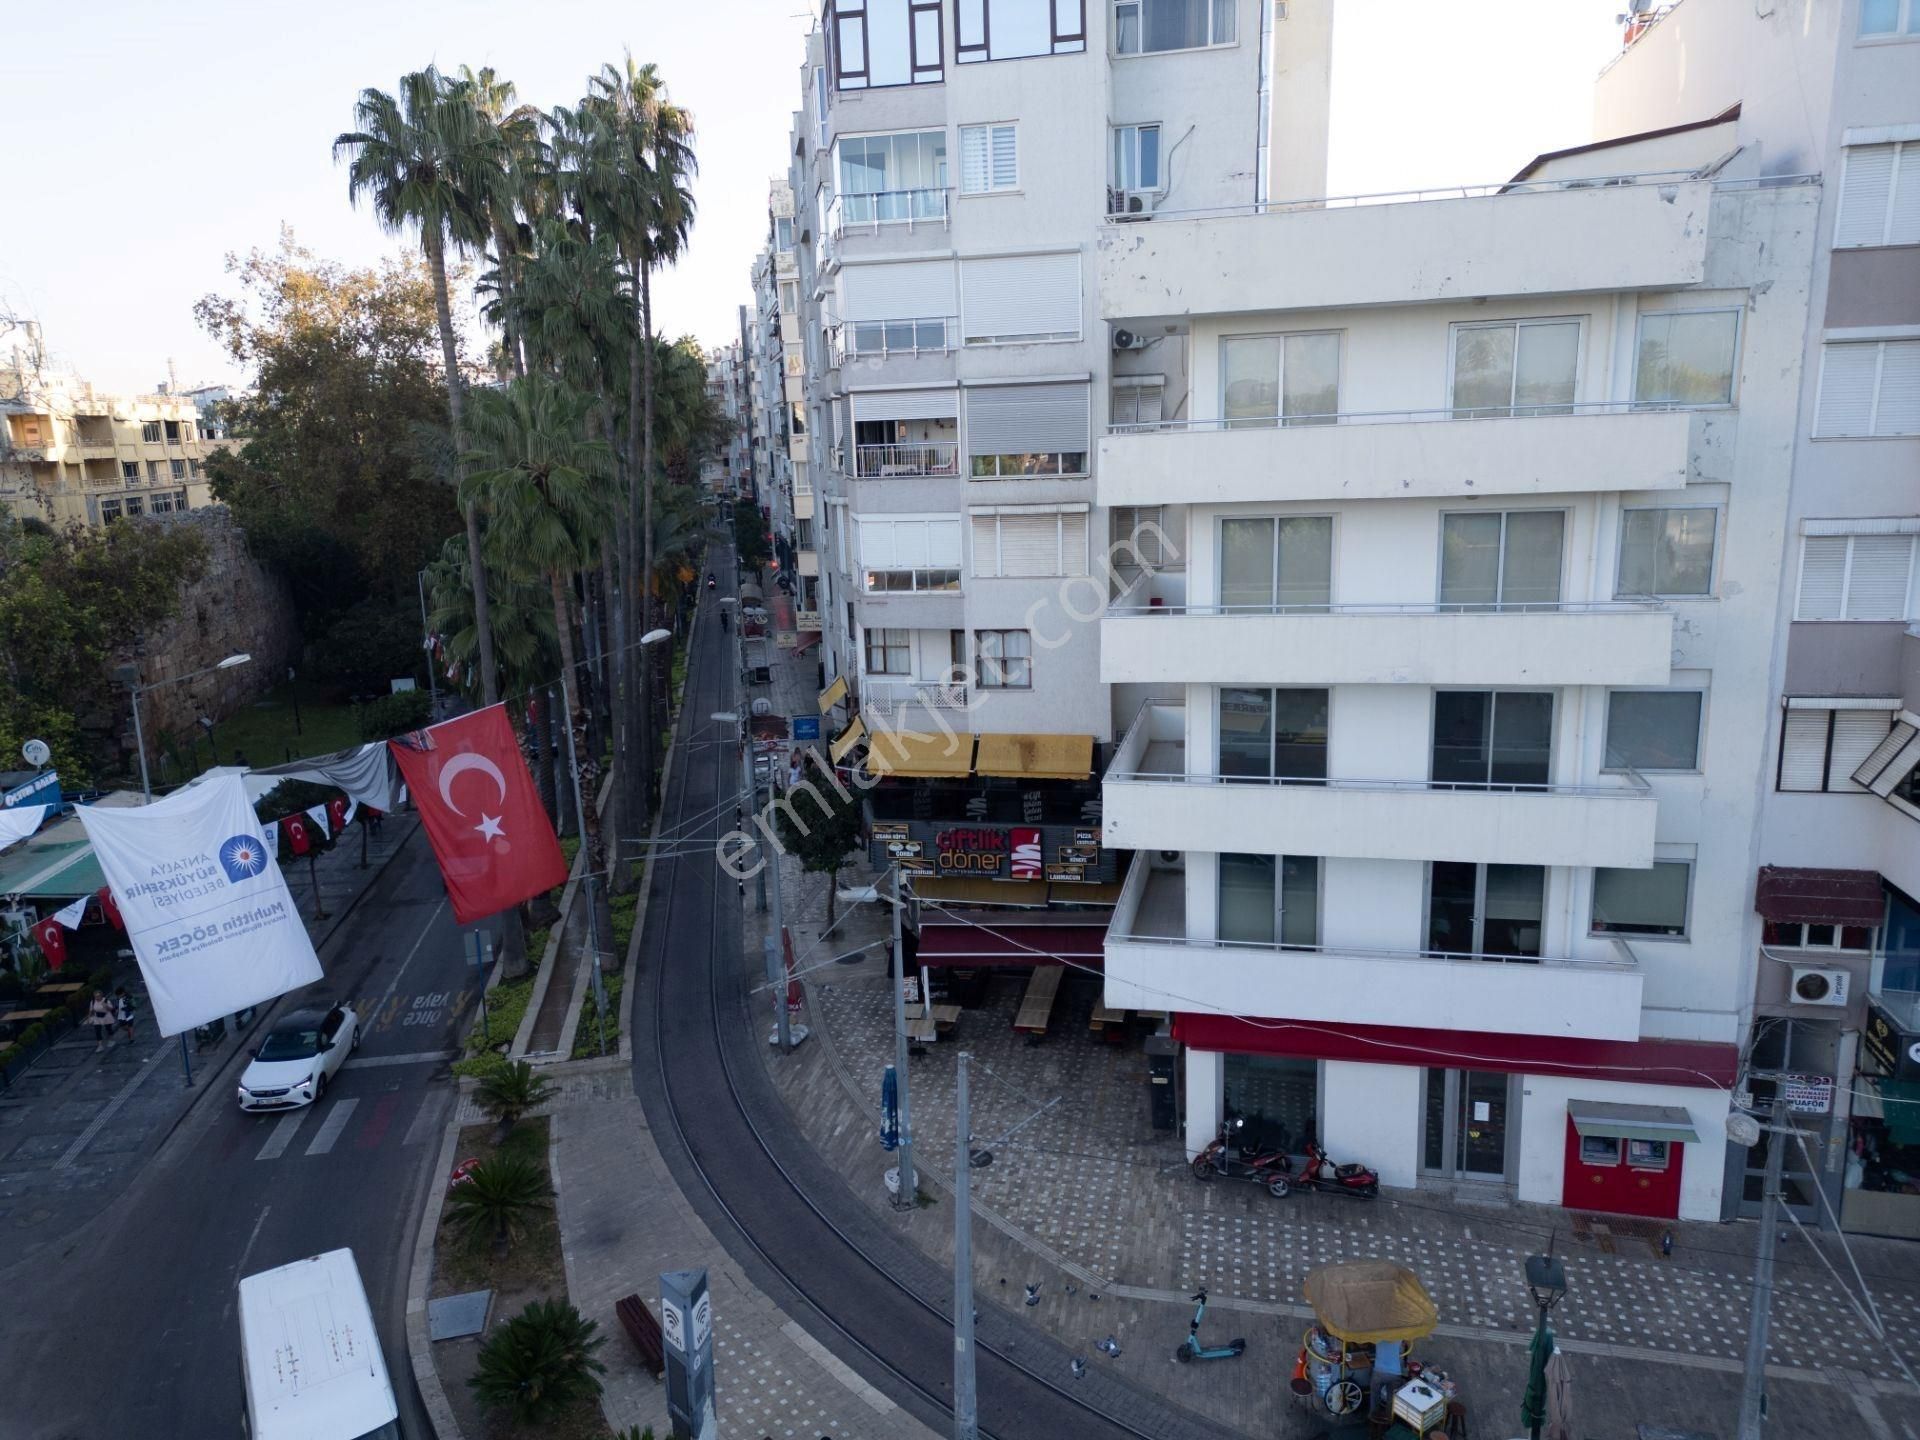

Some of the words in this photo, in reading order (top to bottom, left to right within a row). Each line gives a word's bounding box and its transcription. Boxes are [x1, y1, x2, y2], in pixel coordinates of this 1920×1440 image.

[936, 827, 1004, 851] çiftlik
[940, 848, 1007, 870] döner
[412, 991, 451, 1009] yaya
[402, 1010, 441, 1028] önce
